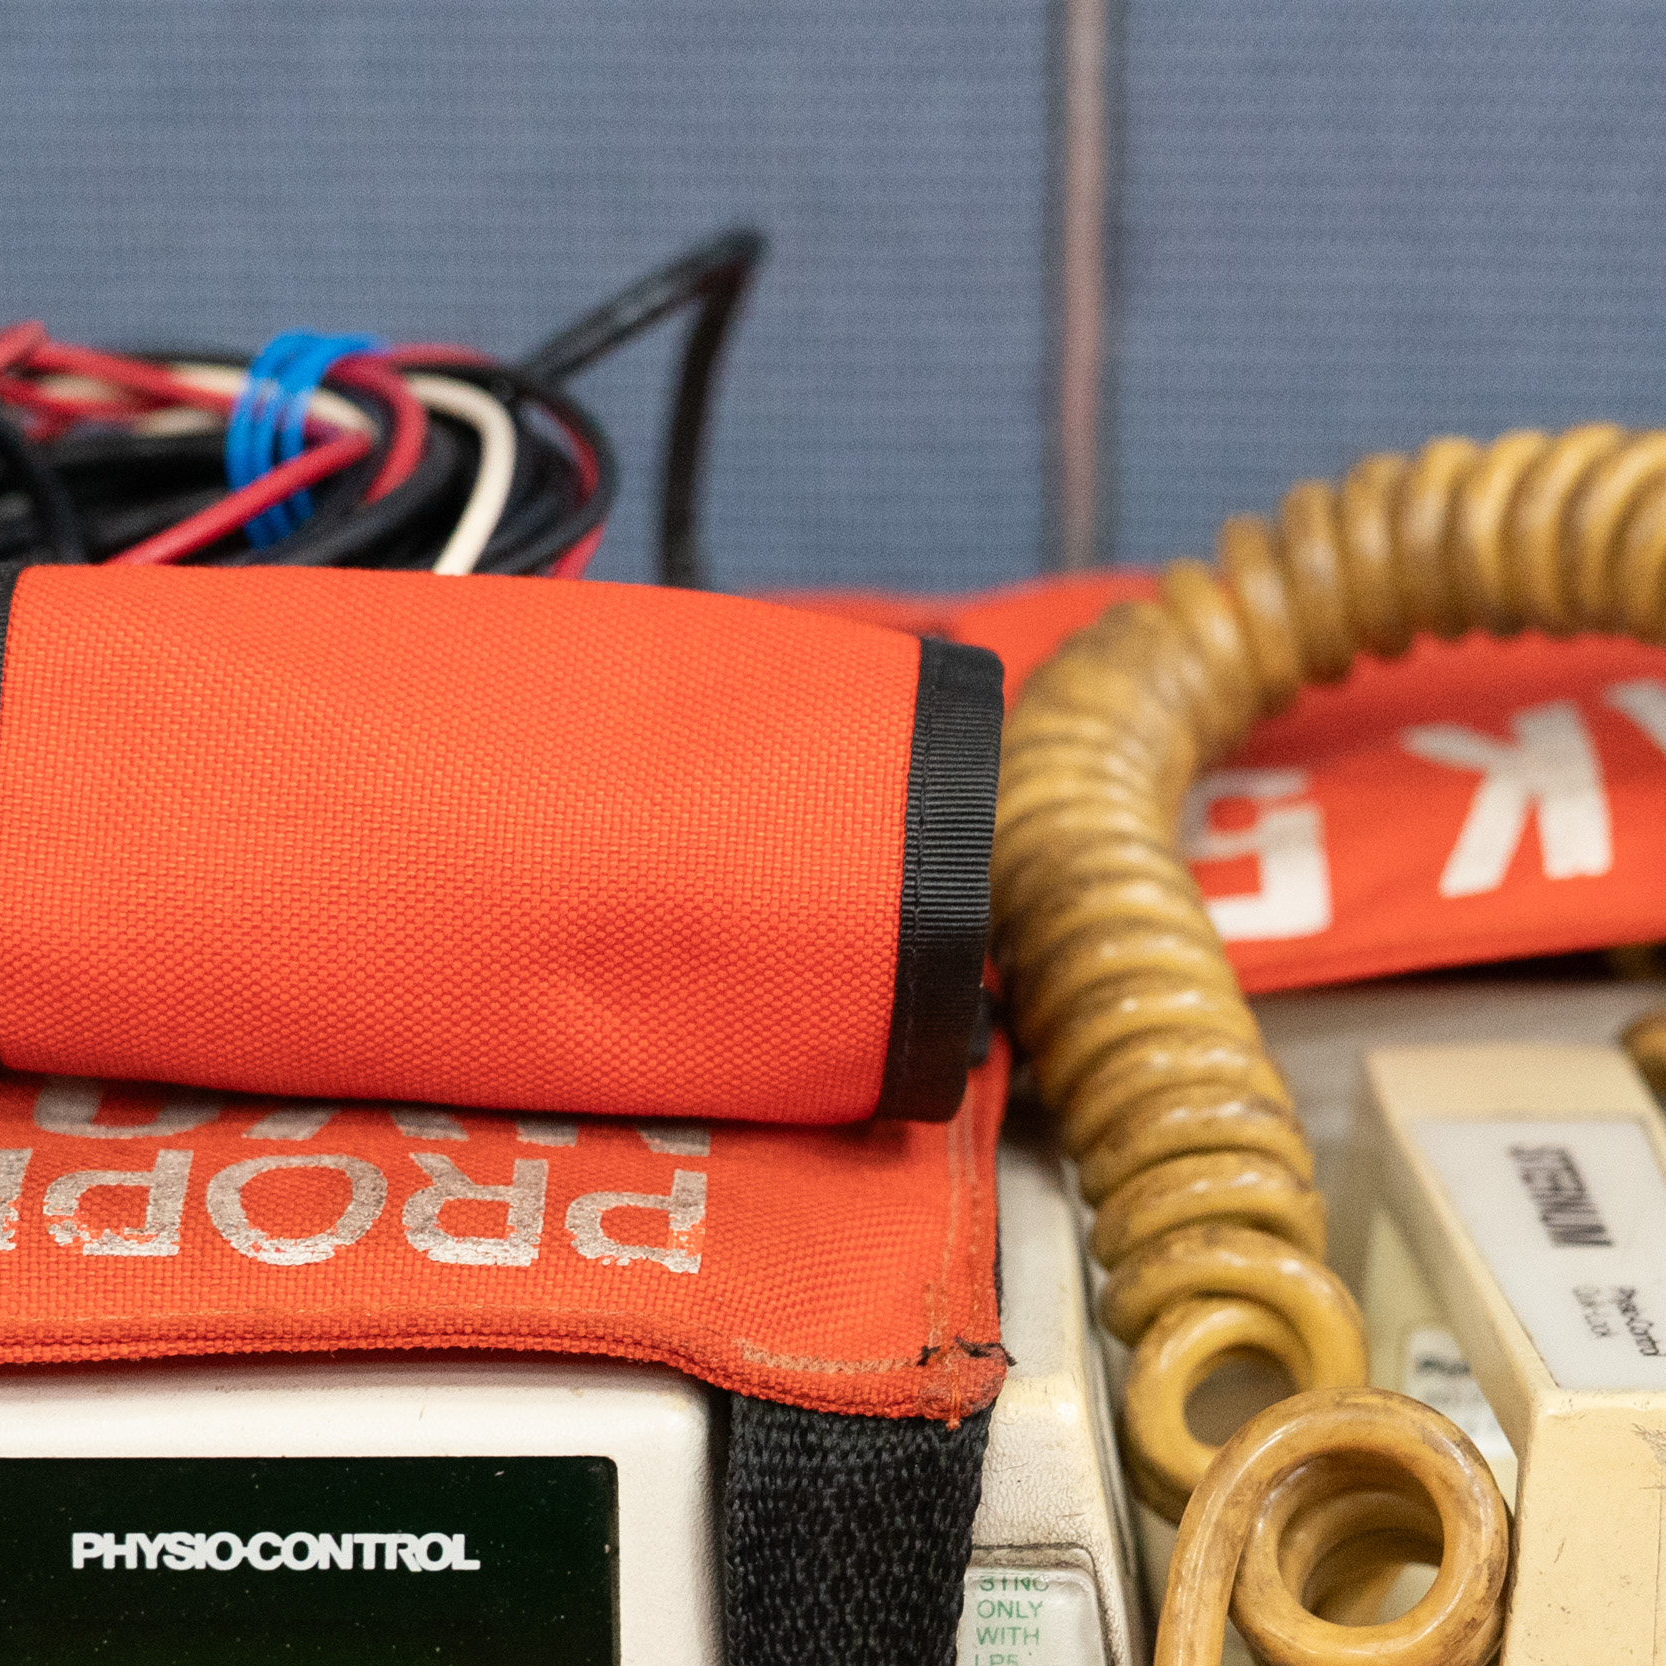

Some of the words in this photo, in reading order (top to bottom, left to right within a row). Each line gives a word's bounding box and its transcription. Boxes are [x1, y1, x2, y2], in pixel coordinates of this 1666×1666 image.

[1179, 768, 1332, 943] 5
[976, 1600, 1043, 1619] ONLY
[976, 1626, 1041, 1646] WITH
